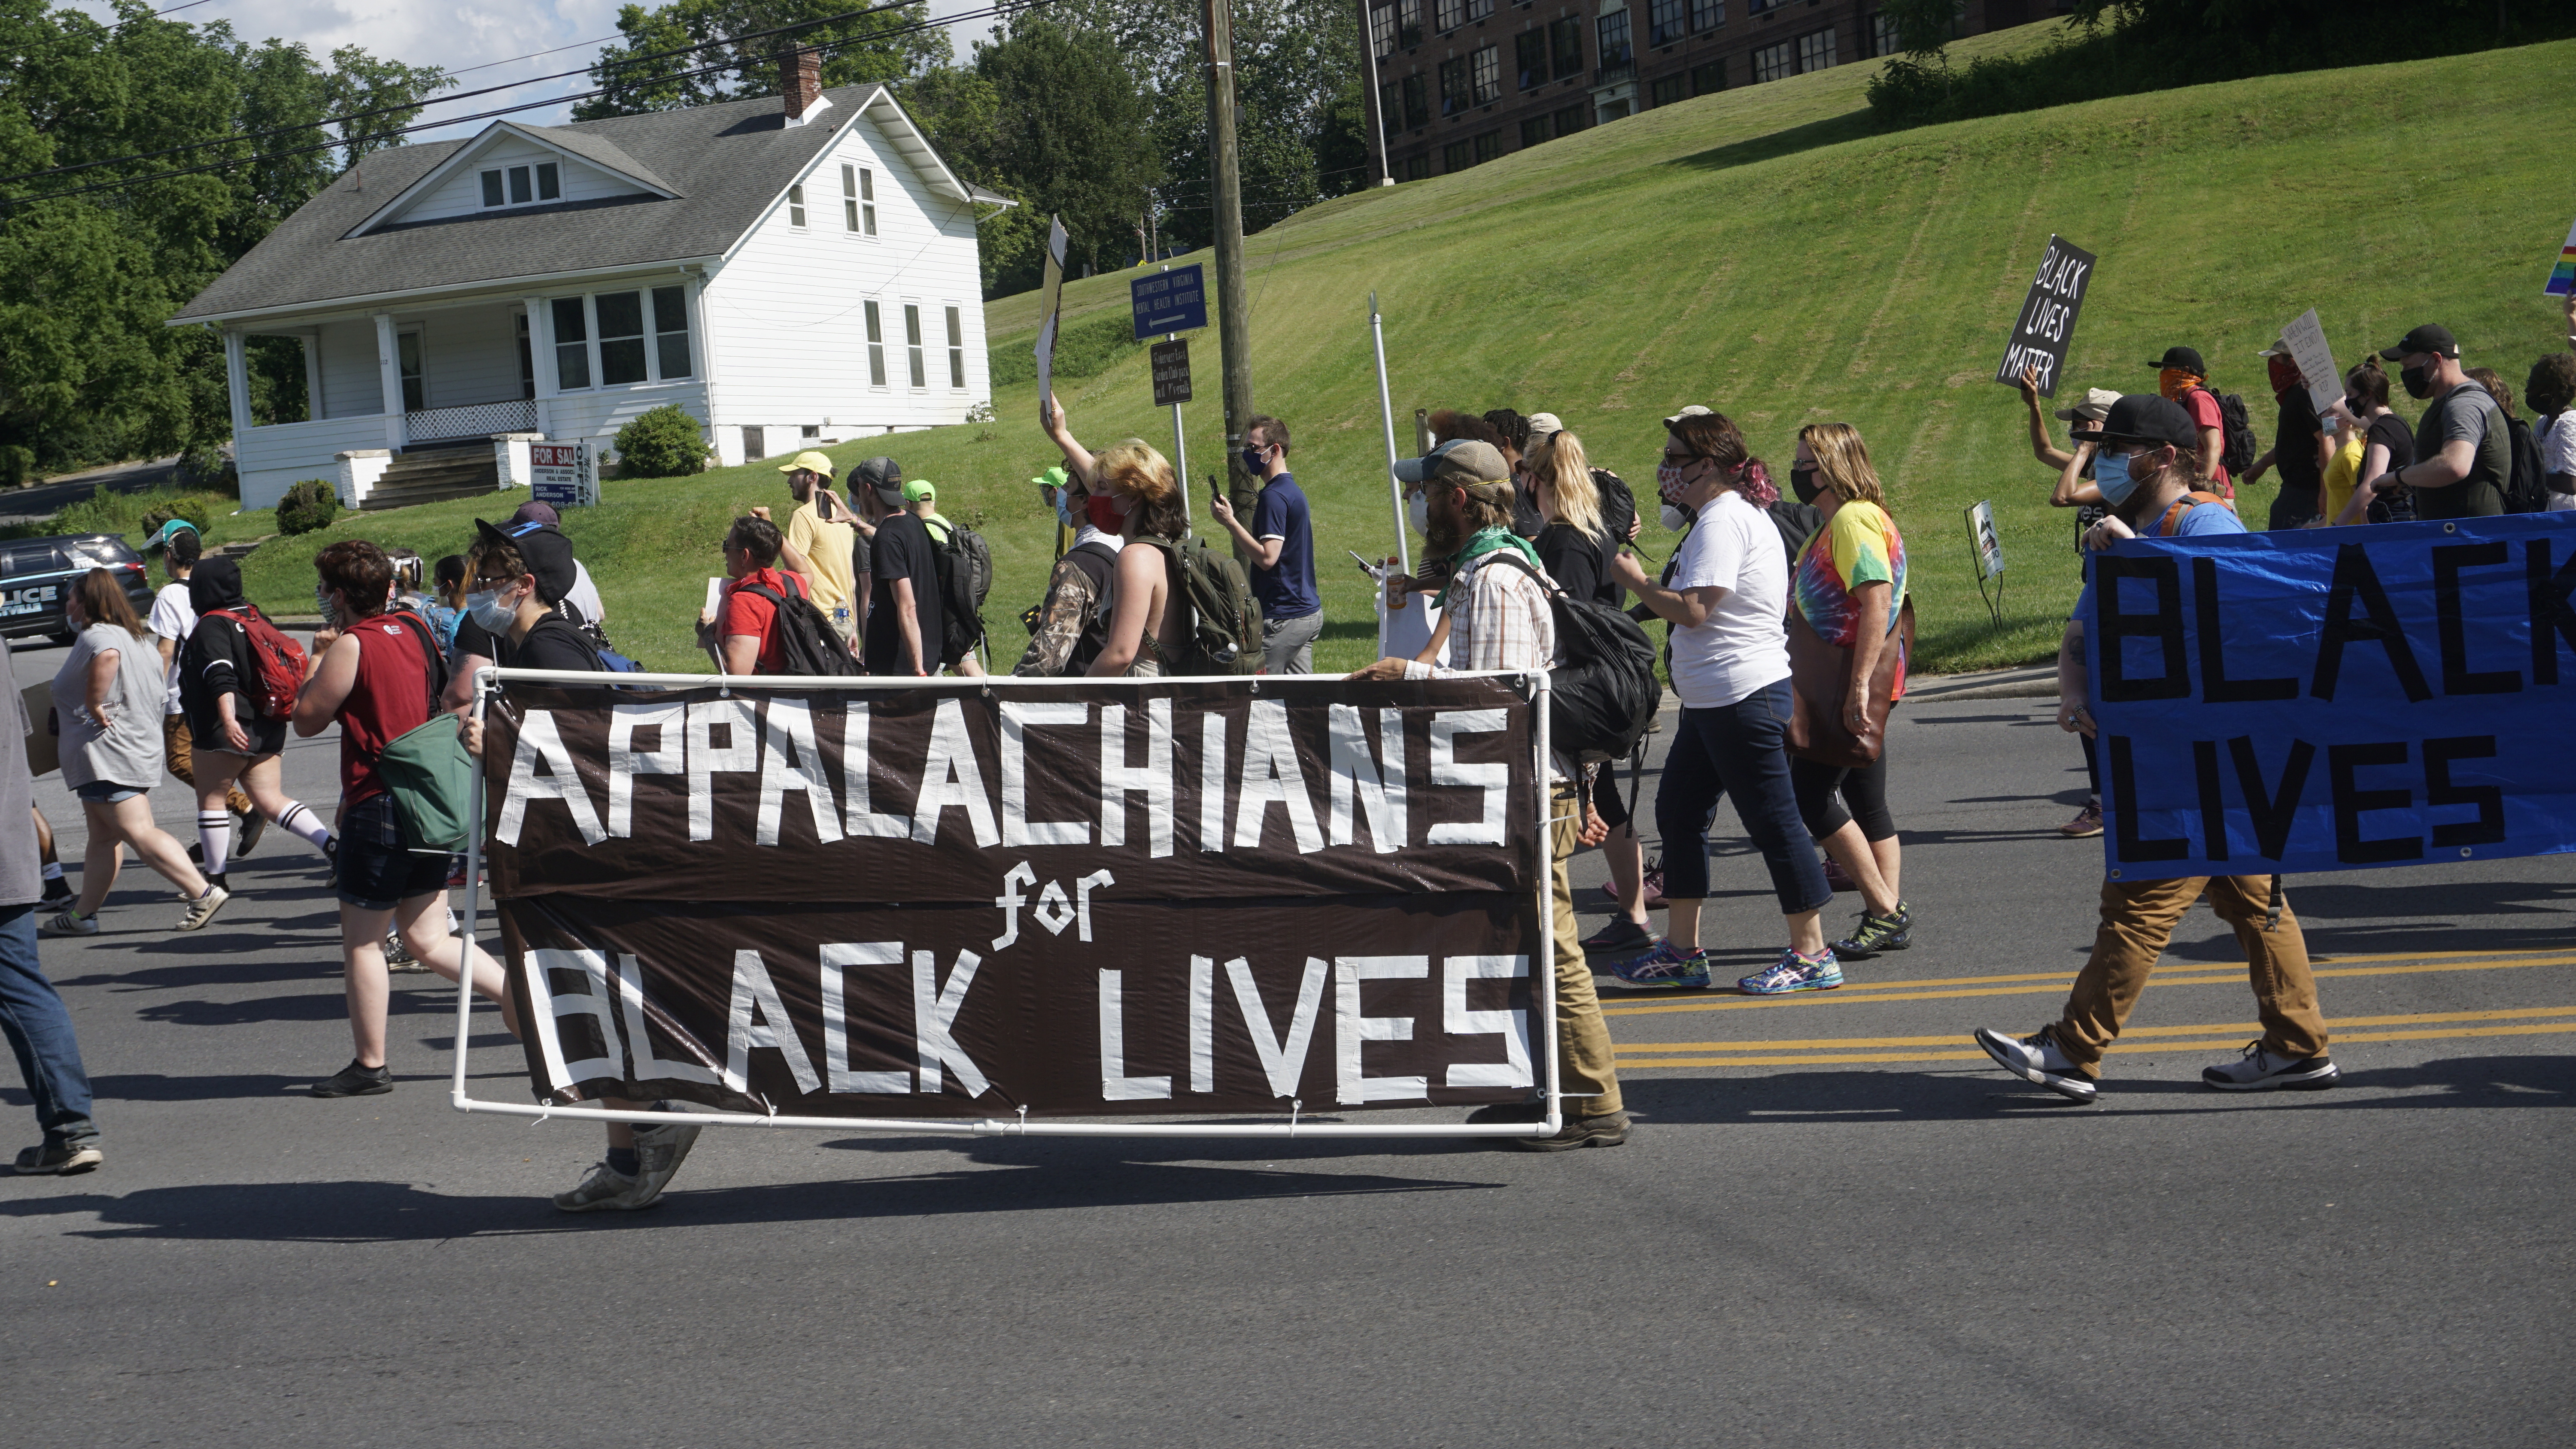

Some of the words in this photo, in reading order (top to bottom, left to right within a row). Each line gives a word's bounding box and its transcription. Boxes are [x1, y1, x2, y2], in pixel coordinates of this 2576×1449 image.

[1137, 279, 1169, 297] SOUTHWESTERN
[1173, 273, 1194, 288] VIRGINIA
[2035, 246, 2087, 300] BLACK
[1136, 301, 1150, 315] MENTAL
[1154, 296, 1170, 310] HEALTH
[1175, 290, 1199, 306] INSTITUTE
[2026, 296, 2069, 343] LIVES
[2283, 322, 2302, 341] WHEN
[2294, 340, 2305, 354] IT
[2305, 329, 2319, 348] END?
[1169, 365, 1178, 379] Club
[2002, 343, 2054, 390] MATTER
[2318, 380, 2329, 393] RIP
[534, 448, 553, 464] FOR
[557, 448, 574, 464] SAL
[1, 585, 58, 606] LICE
[495, 697, 1508, 858] APPALACHIANS
[2108, 734, 2506, 864] LIVES
[992, 861, 1115, 951] for
[524, 941, 990, 1099] BLACK
[1099, 954, 1534, 1105] LIVES
